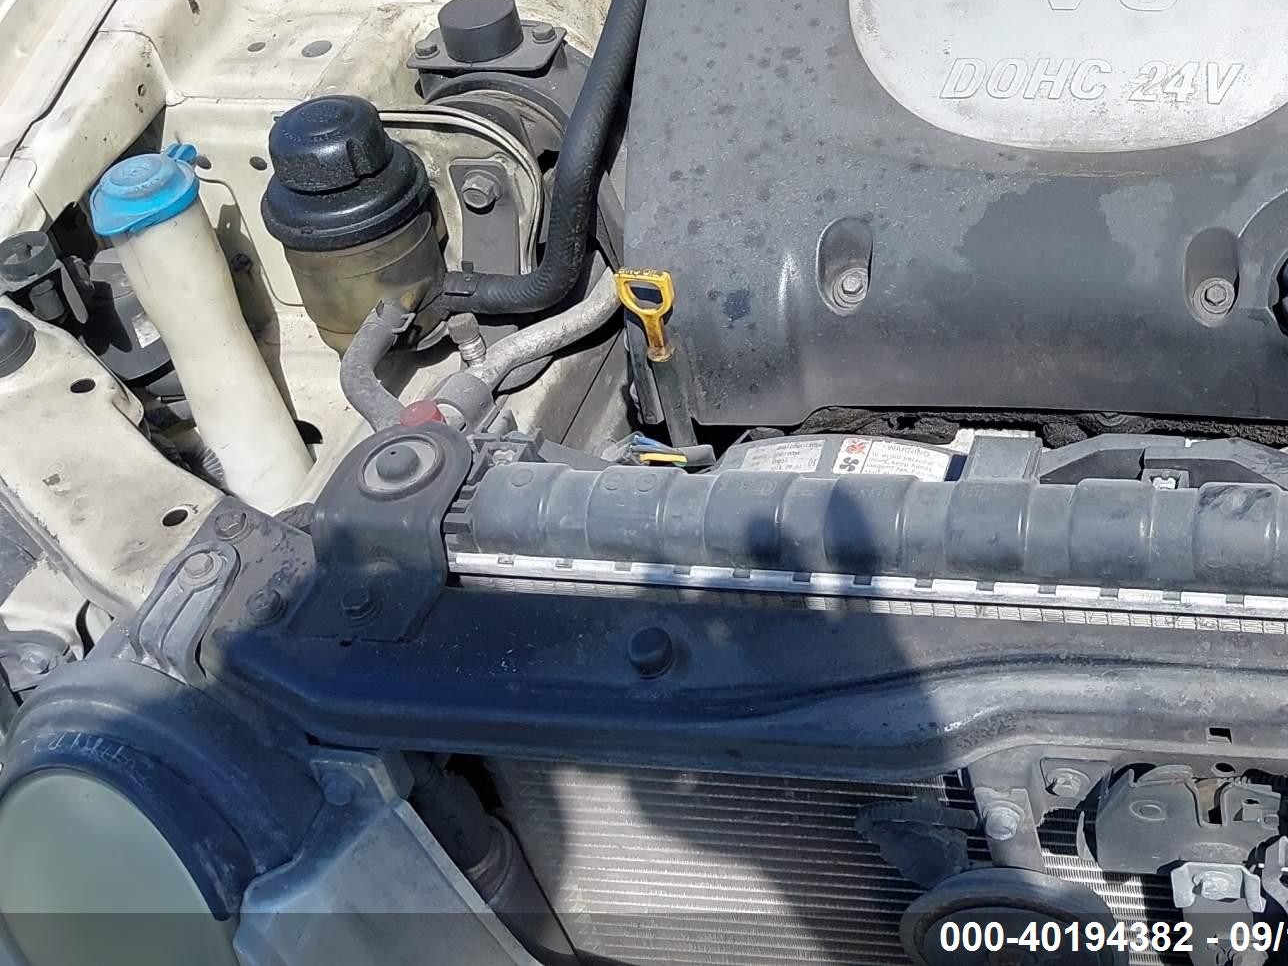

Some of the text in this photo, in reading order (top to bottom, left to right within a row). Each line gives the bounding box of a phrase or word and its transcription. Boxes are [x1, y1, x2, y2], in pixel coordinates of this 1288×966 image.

[939, 57, 1245, 105] DOHC 24V
[887, 445, 931, 458] WARNING
